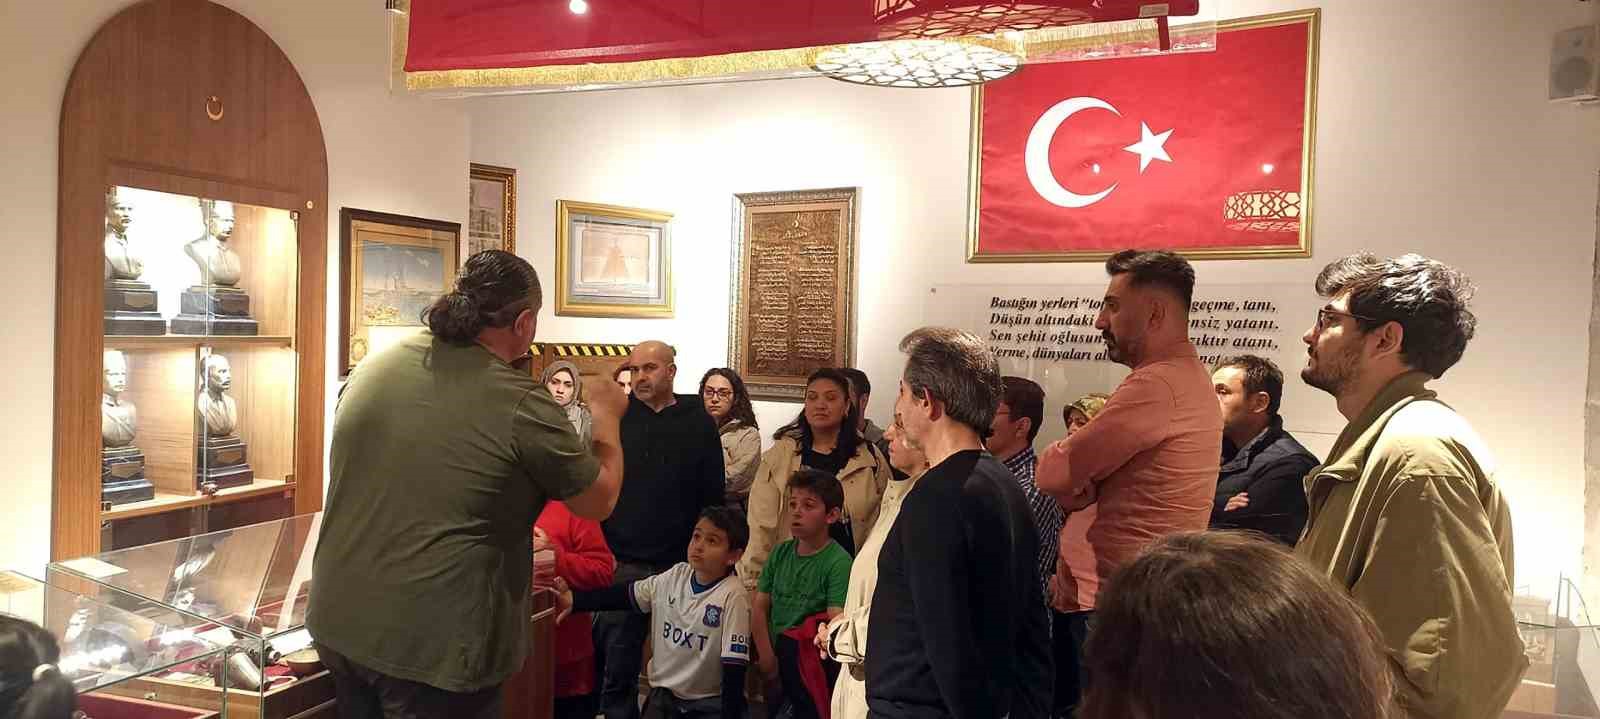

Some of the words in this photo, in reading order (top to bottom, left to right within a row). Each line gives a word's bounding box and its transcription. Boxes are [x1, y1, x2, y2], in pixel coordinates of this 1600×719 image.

[990, 296, 1037, 310] Bastığın
[1040, 296, 1079, 311] yerleri
[1243, 299, 1276, 312] tanı,
[990, 312, 1031, 328] Düşün
[1035, 313, 1095, 326] altındaki
[1223, 318, 1279, 331] yatanı.
[990, 328, 1012, 341] Sen
[1016, 330, 1046, 344] şehit
[1032, 347, 1091, 362] dünyaları
[663, 621, 709, 651] BOXT
